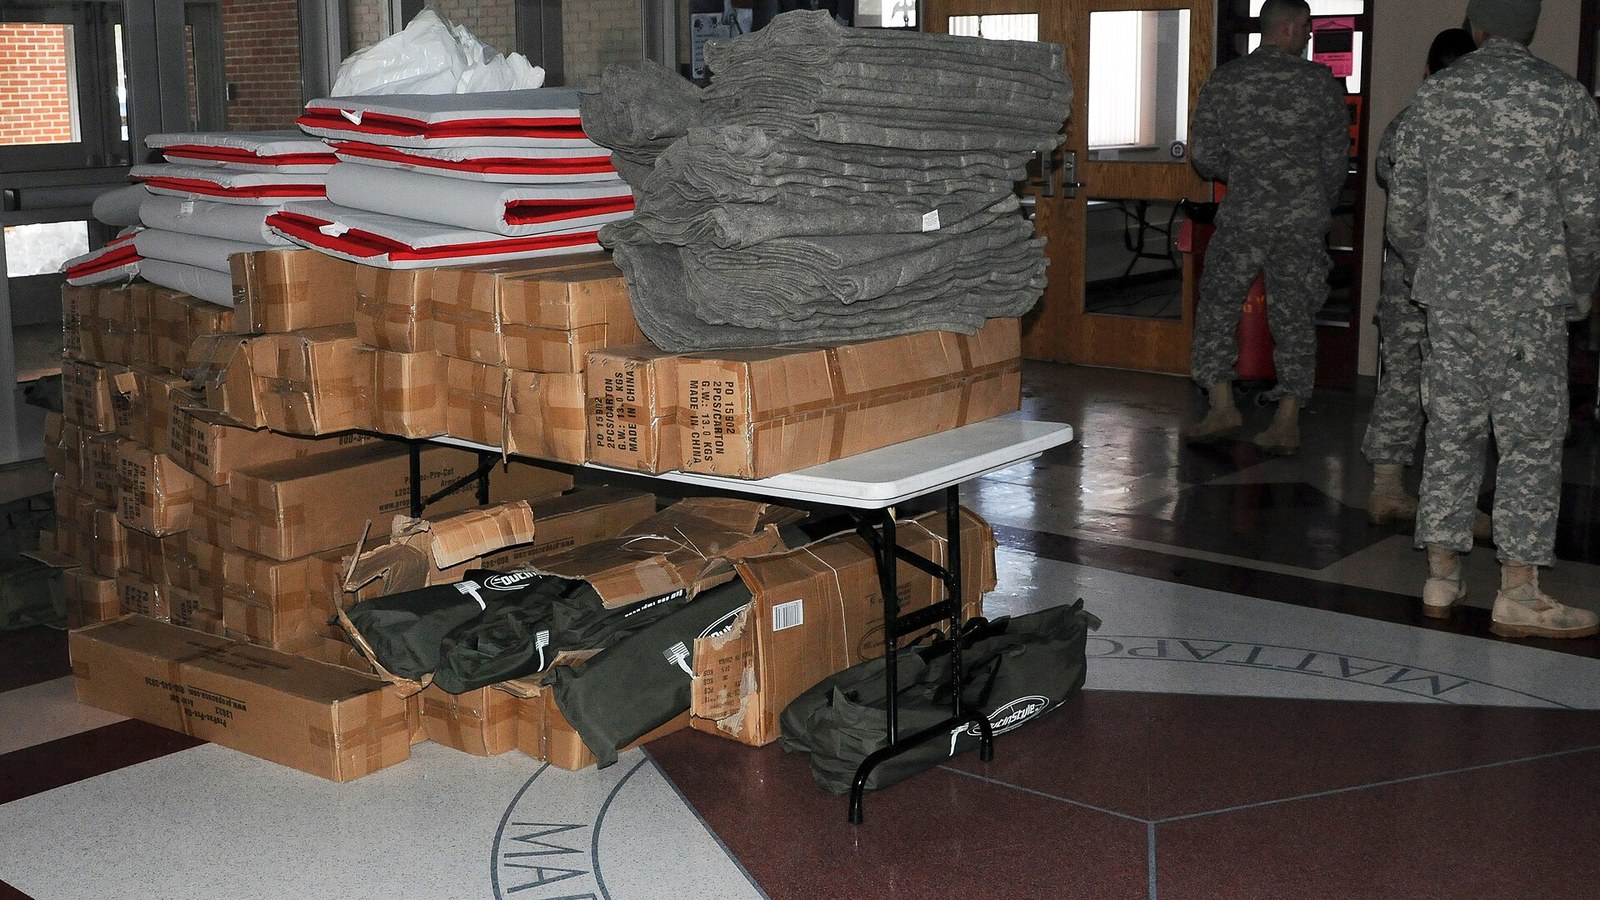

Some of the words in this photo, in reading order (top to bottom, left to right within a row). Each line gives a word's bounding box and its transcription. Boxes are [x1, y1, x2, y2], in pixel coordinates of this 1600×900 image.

[614, 371, 624, 392] KGS
[625, 369, 636, 402] CHINA
[701, 380, 711, 407] G.W.:
[725, 381, 735, 395] PO
[689, 380, 699, 410] MADE
[604, 378, 616, 449] 2PCS/CARTON
[615, 397, 625, 419] 13.0
[627, 407, 636, 418] IN
[690, 415, 699, 426] IN
[712, 381, 725, 455] 2PCS/CARTON
[725, 401, 736, 434] 15902
[701, 413, 711, 436] 13.0
[596, 433, 605, 447] PO
[617, 425, 627, 450] G.W.:
[628, 423, 638, 452] MADE
[691, 432, 702, 464] CHINA
[703, 441, 713, 462] KGS
